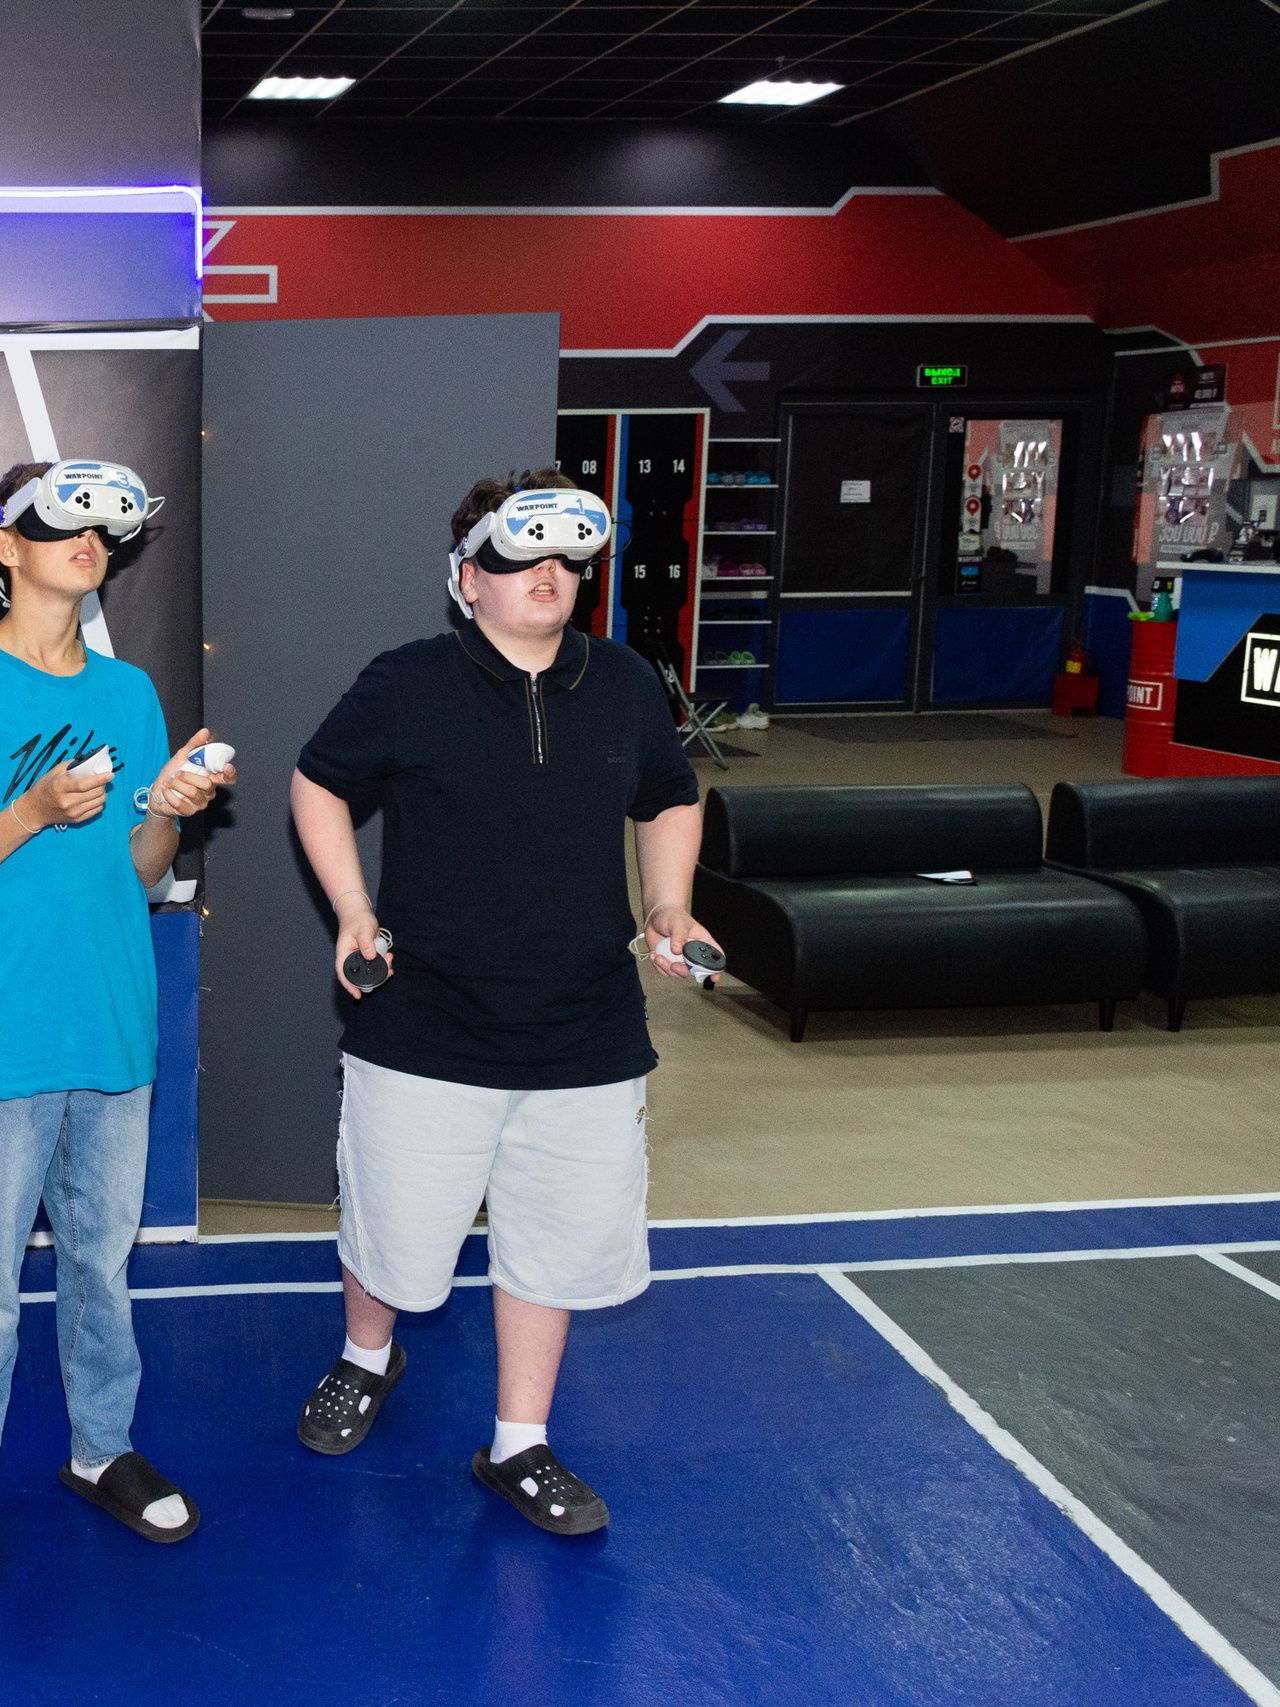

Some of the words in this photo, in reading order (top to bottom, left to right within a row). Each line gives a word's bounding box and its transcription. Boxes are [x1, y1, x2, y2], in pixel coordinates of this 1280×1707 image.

[924, 367, 961, 377] ВЫХОД
[931, 376, 953, 385] EXIT
[582, 460, 597, 474] 08
[638, 459, 651, 473] 13
[672, 459, 685, 473] 14
[63, 472, 104, 480] WARPOINT
[116, 471, 130, 488] 3
[516, 502, 559, 512] WARPOINT
[575, 497, 585, 514] 1
[581, 565, 593, 580] 0
[634, 565, 646, 579] 15
[669, 565, 681, 579] 16
[1253, 647, 1280, 693] W
[1127, 684, 1153, 704] OINT
